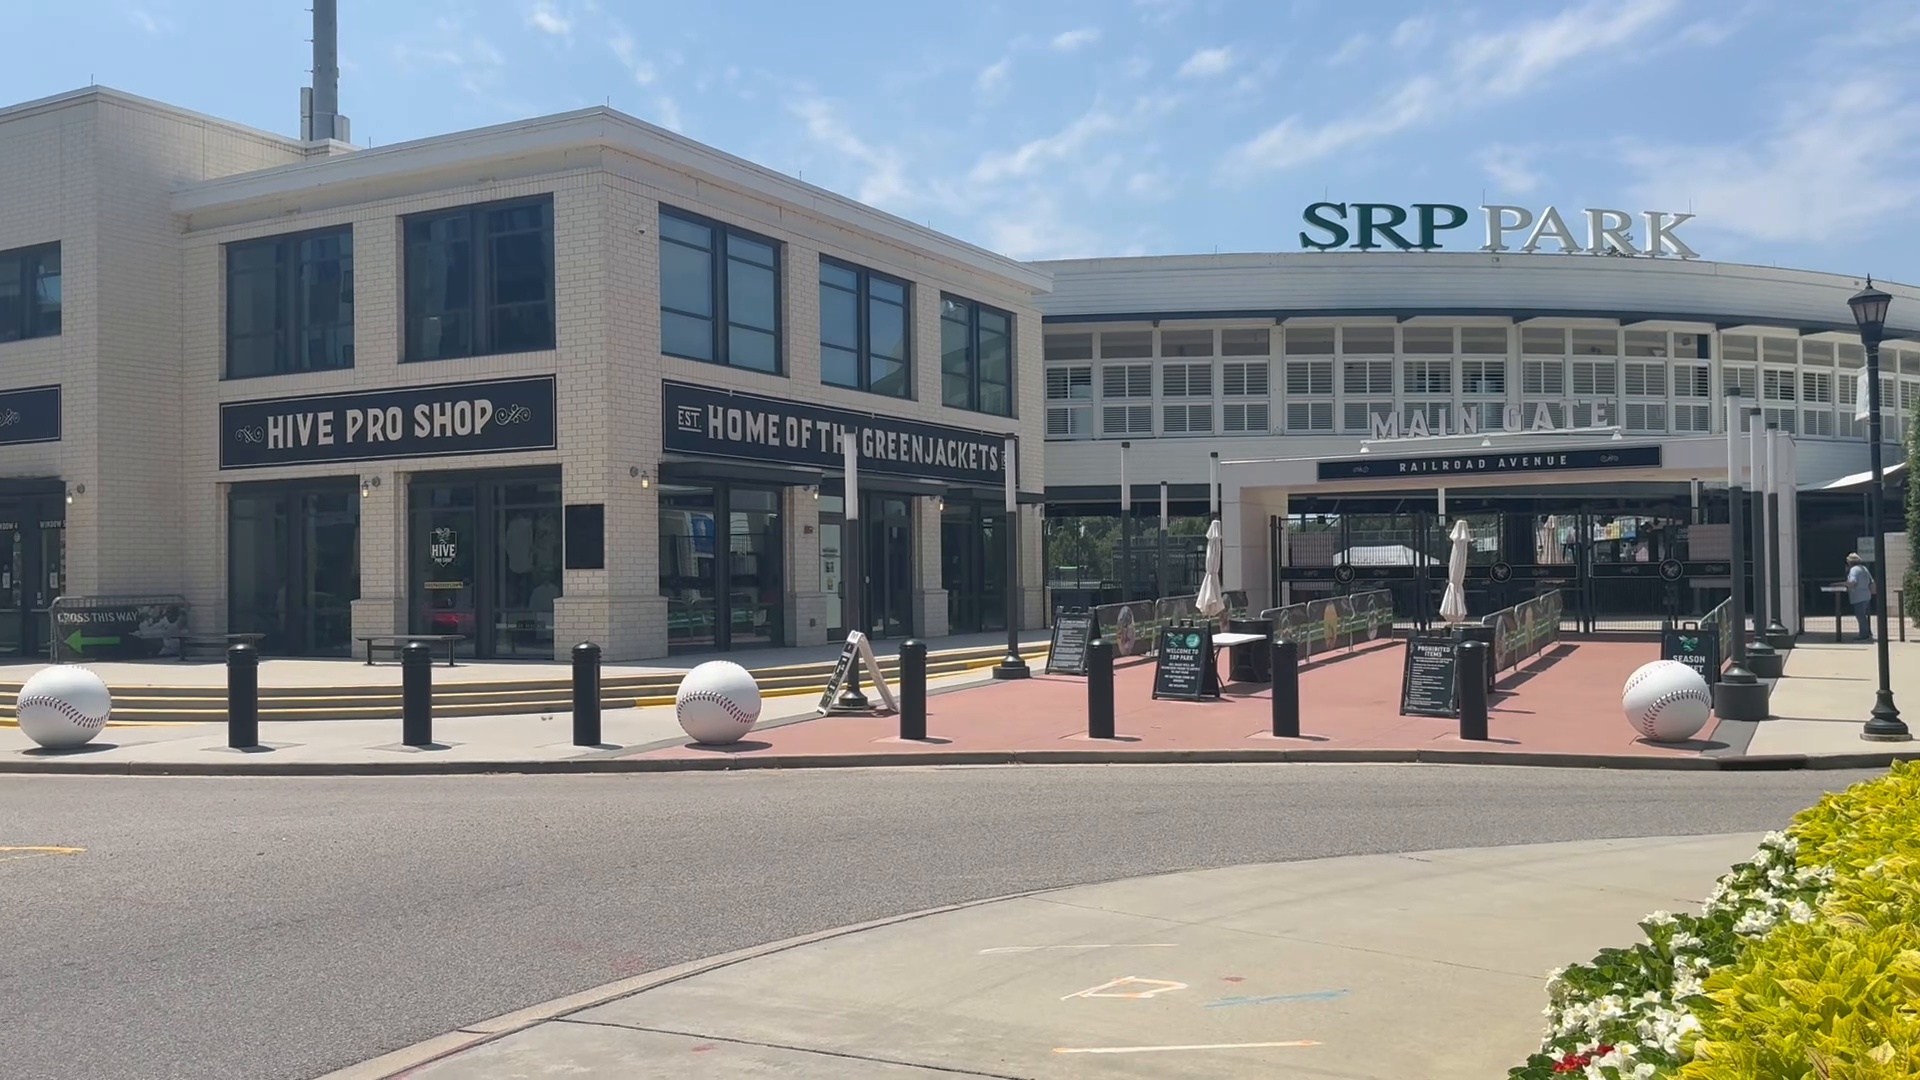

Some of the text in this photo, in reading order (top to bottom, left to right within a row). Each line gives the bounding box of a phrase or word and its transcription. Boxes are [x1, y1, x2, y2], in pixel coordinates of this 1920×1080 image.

[1299, 202, 1700, 257] SRP PARK
[267, 399, 493, 449] HIVE PRO SHOP
[678, 409, 702, 428] EST.
[1370, 397, 1610, 440] MAIN GATE
[707, 404, 780, 447] HOME
[786, 416, 813, 449] OF
[816, 420, 858, 457] TH
[1400, 455, 1567, 472] RAILROAD AVENUE
[432, 544, 455, 557] HIVE
[57, 611, 139, 623] CROSS THIS WAY
[1417, 645, 1451, 653] PROHIBITED
[1672, 655, 1705, 663] SEASON
